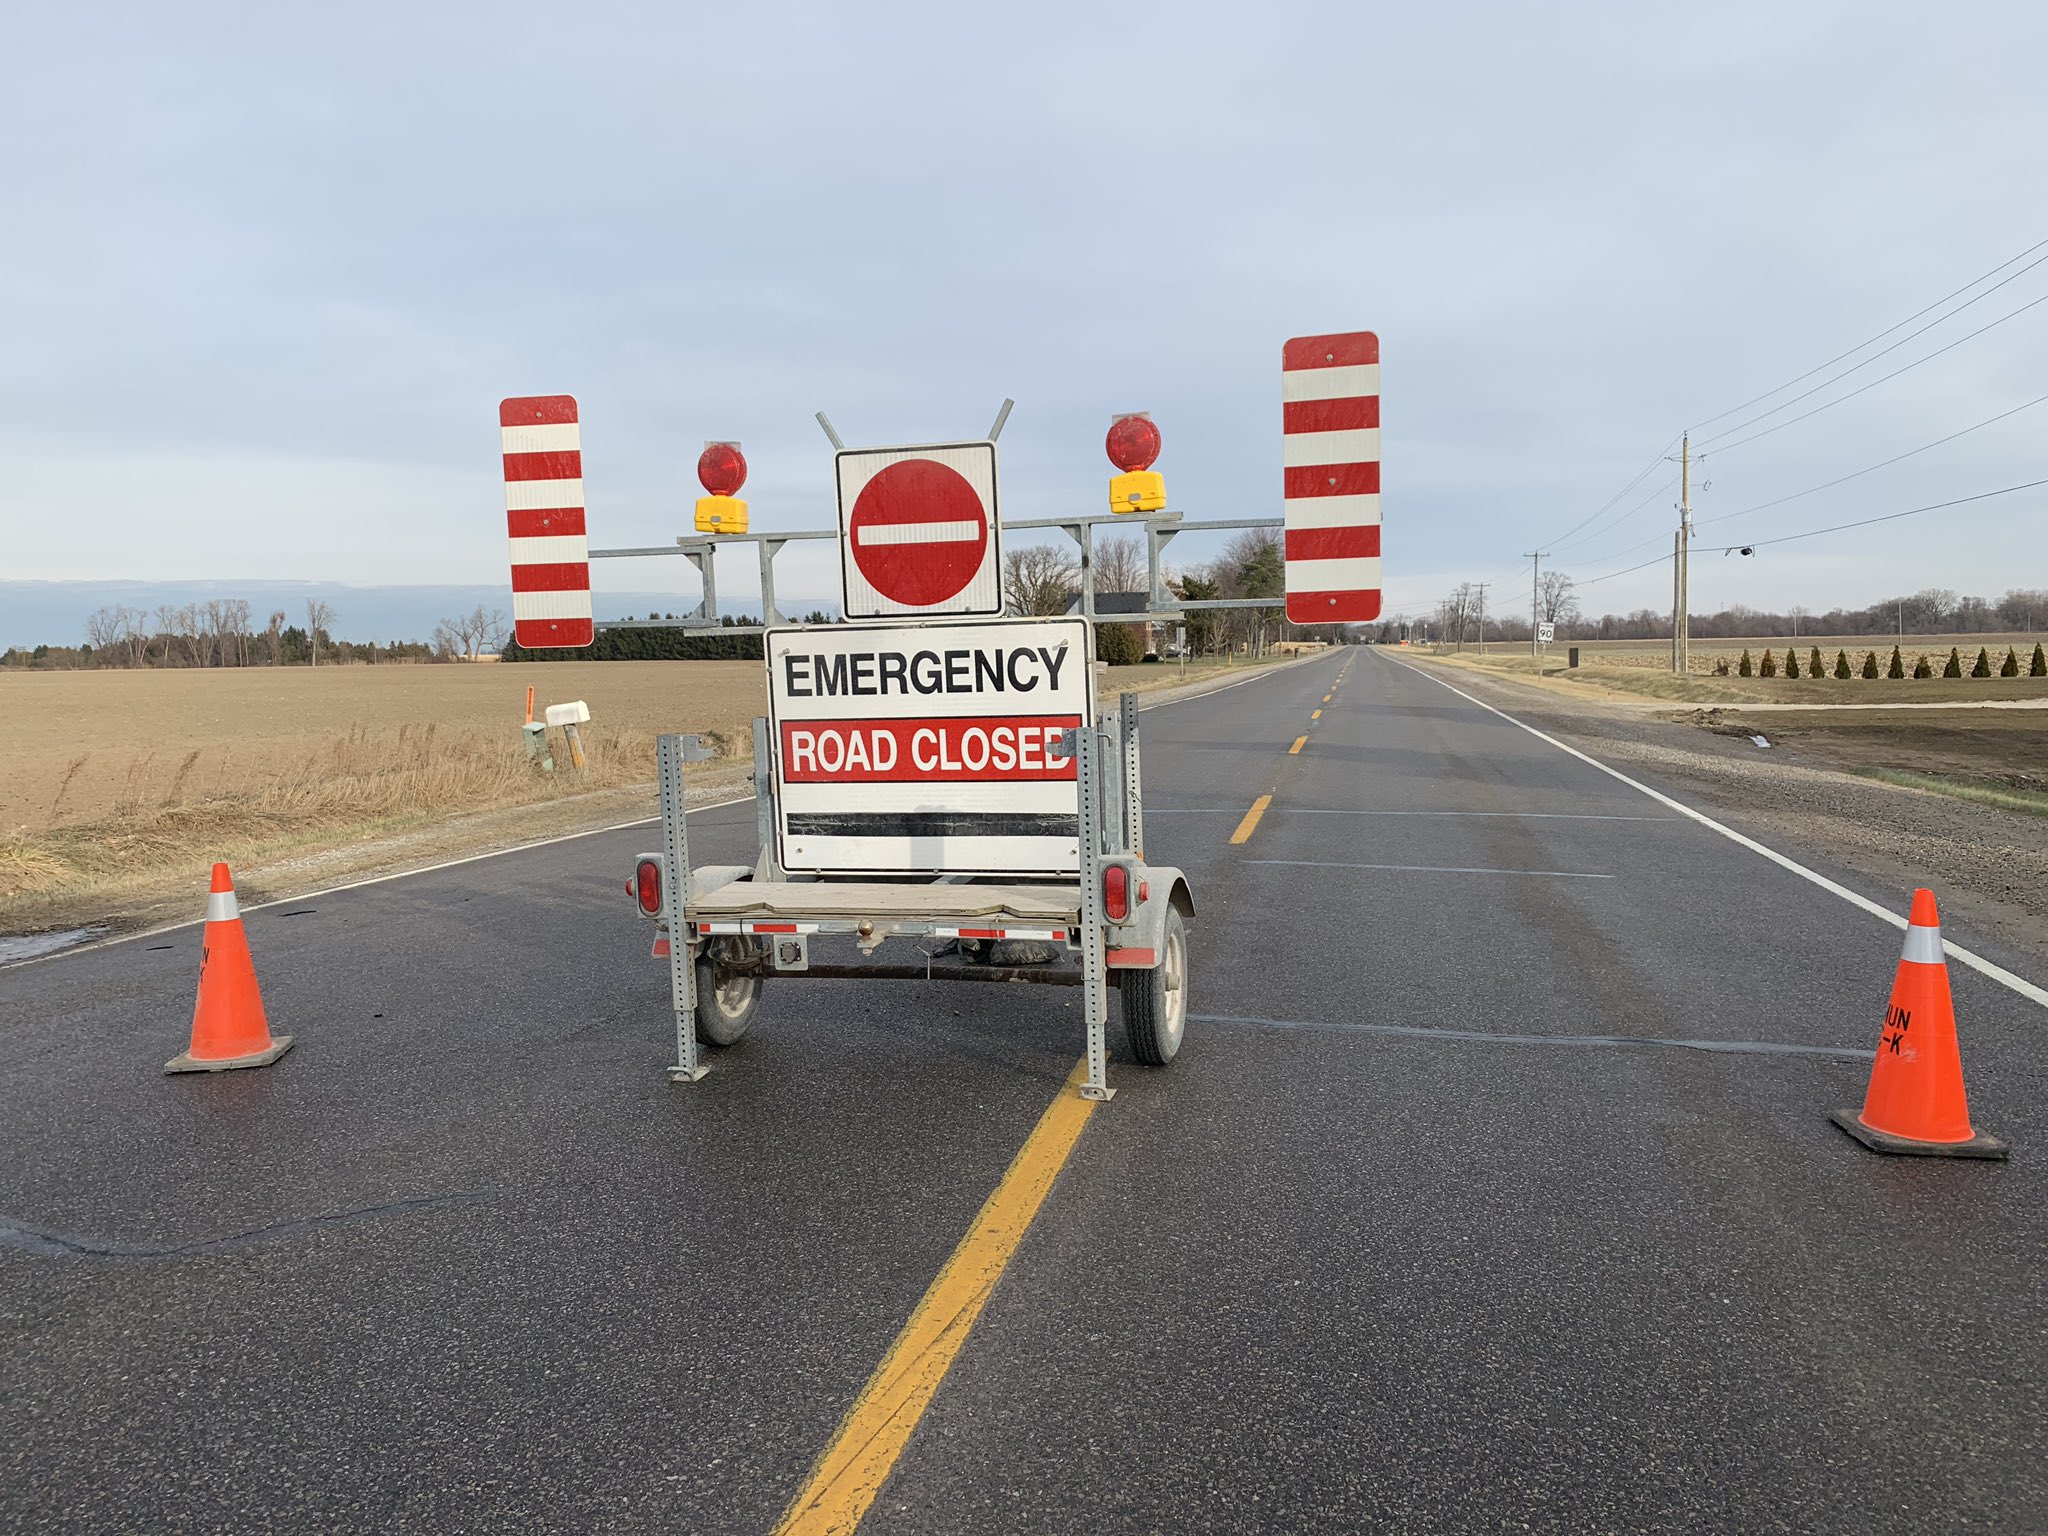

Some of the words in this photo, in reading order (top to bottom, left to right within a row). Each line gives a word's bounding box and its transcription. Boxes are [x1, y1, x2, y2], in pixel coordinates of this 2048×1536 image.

[1540, 630, 1552, 638] 90
[785, 647, 1068, 697] EMERGENCY
[791, 729, 897, 772] ROAD
[911, 727, 1071, 772] CLOSED
[1885, 1003, 1911, 1031] UN
